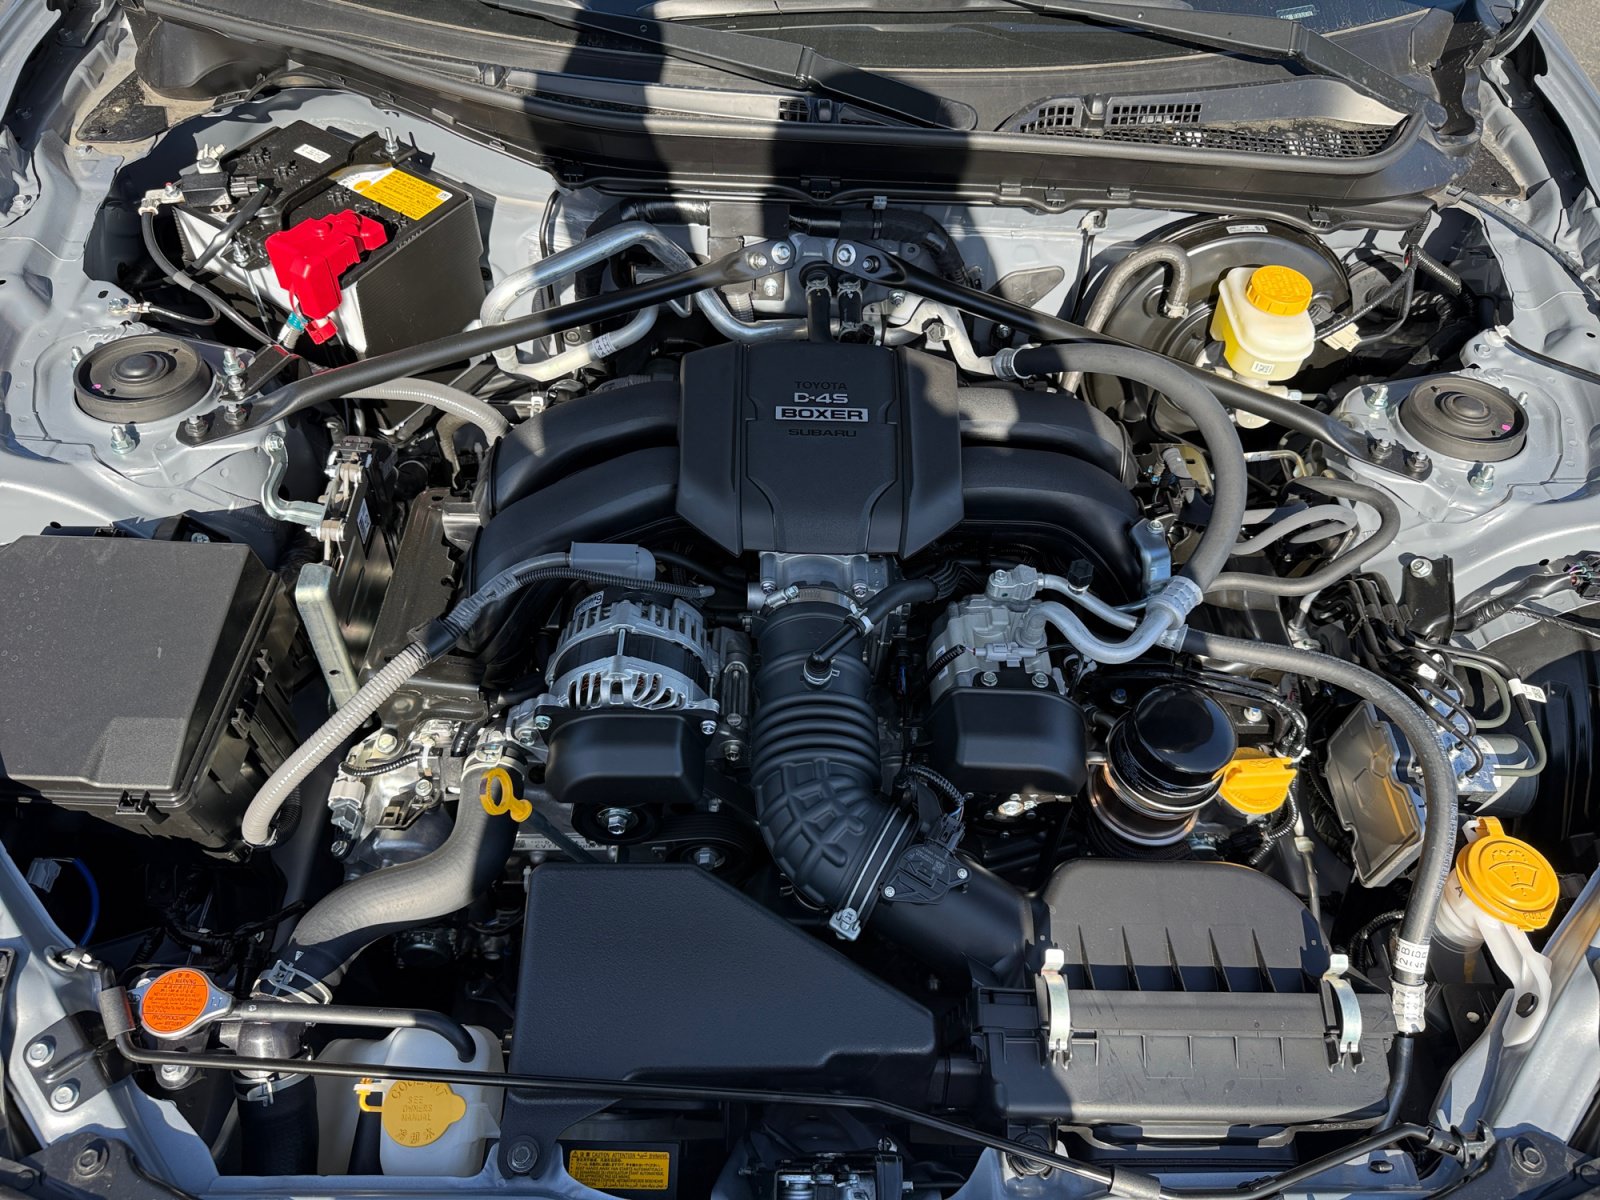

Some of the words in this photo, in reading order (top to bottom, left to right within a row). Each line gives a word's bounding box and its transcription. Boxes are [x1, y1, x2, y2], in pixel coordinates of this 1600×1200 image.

[794, 381, 848, 390] TOYOTA
[781, 407, 864, 420] BOXER
[788, 429, 857, 437] SUBARU
[408, 1096, 424, 1104] SEE
[401, 1113, 431, 1121] MANUAL
